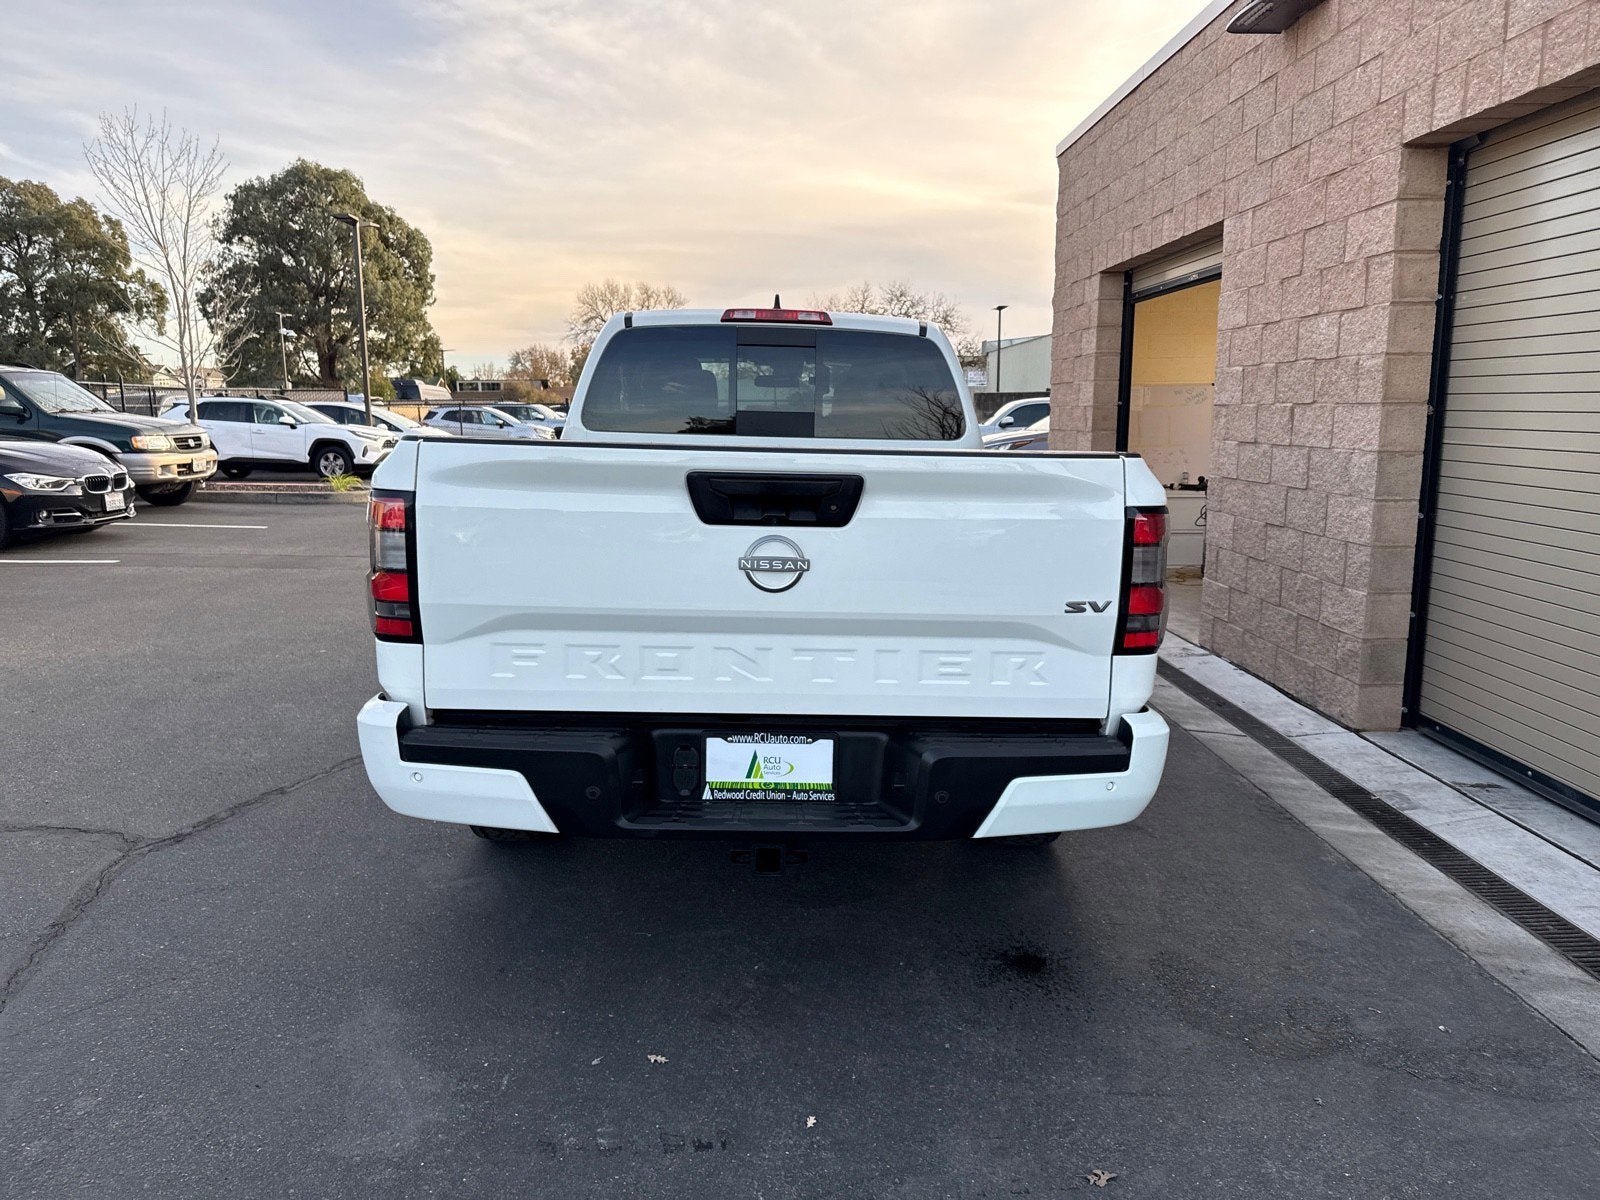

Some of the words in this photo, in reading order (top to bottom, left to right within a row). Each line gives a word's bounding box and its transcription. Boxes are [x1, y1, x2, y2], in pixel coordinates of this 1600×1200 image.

[740, 559, 808, 570] NISSAN
[1064, 600, 1112, 613] SV
[490, 642, 1049, 686] FRONTIER
[732, 732, 807, 744] www.RCUauto.com
[763, 756, 781, 764] RCU
[713, 790, 744, 800] Redwood
[745, 790, 765, 800] Credit
[766, 790, 786, 800] Union
[792, 791, 808, 800] Auto
[809, 791, 836, 801] Services
